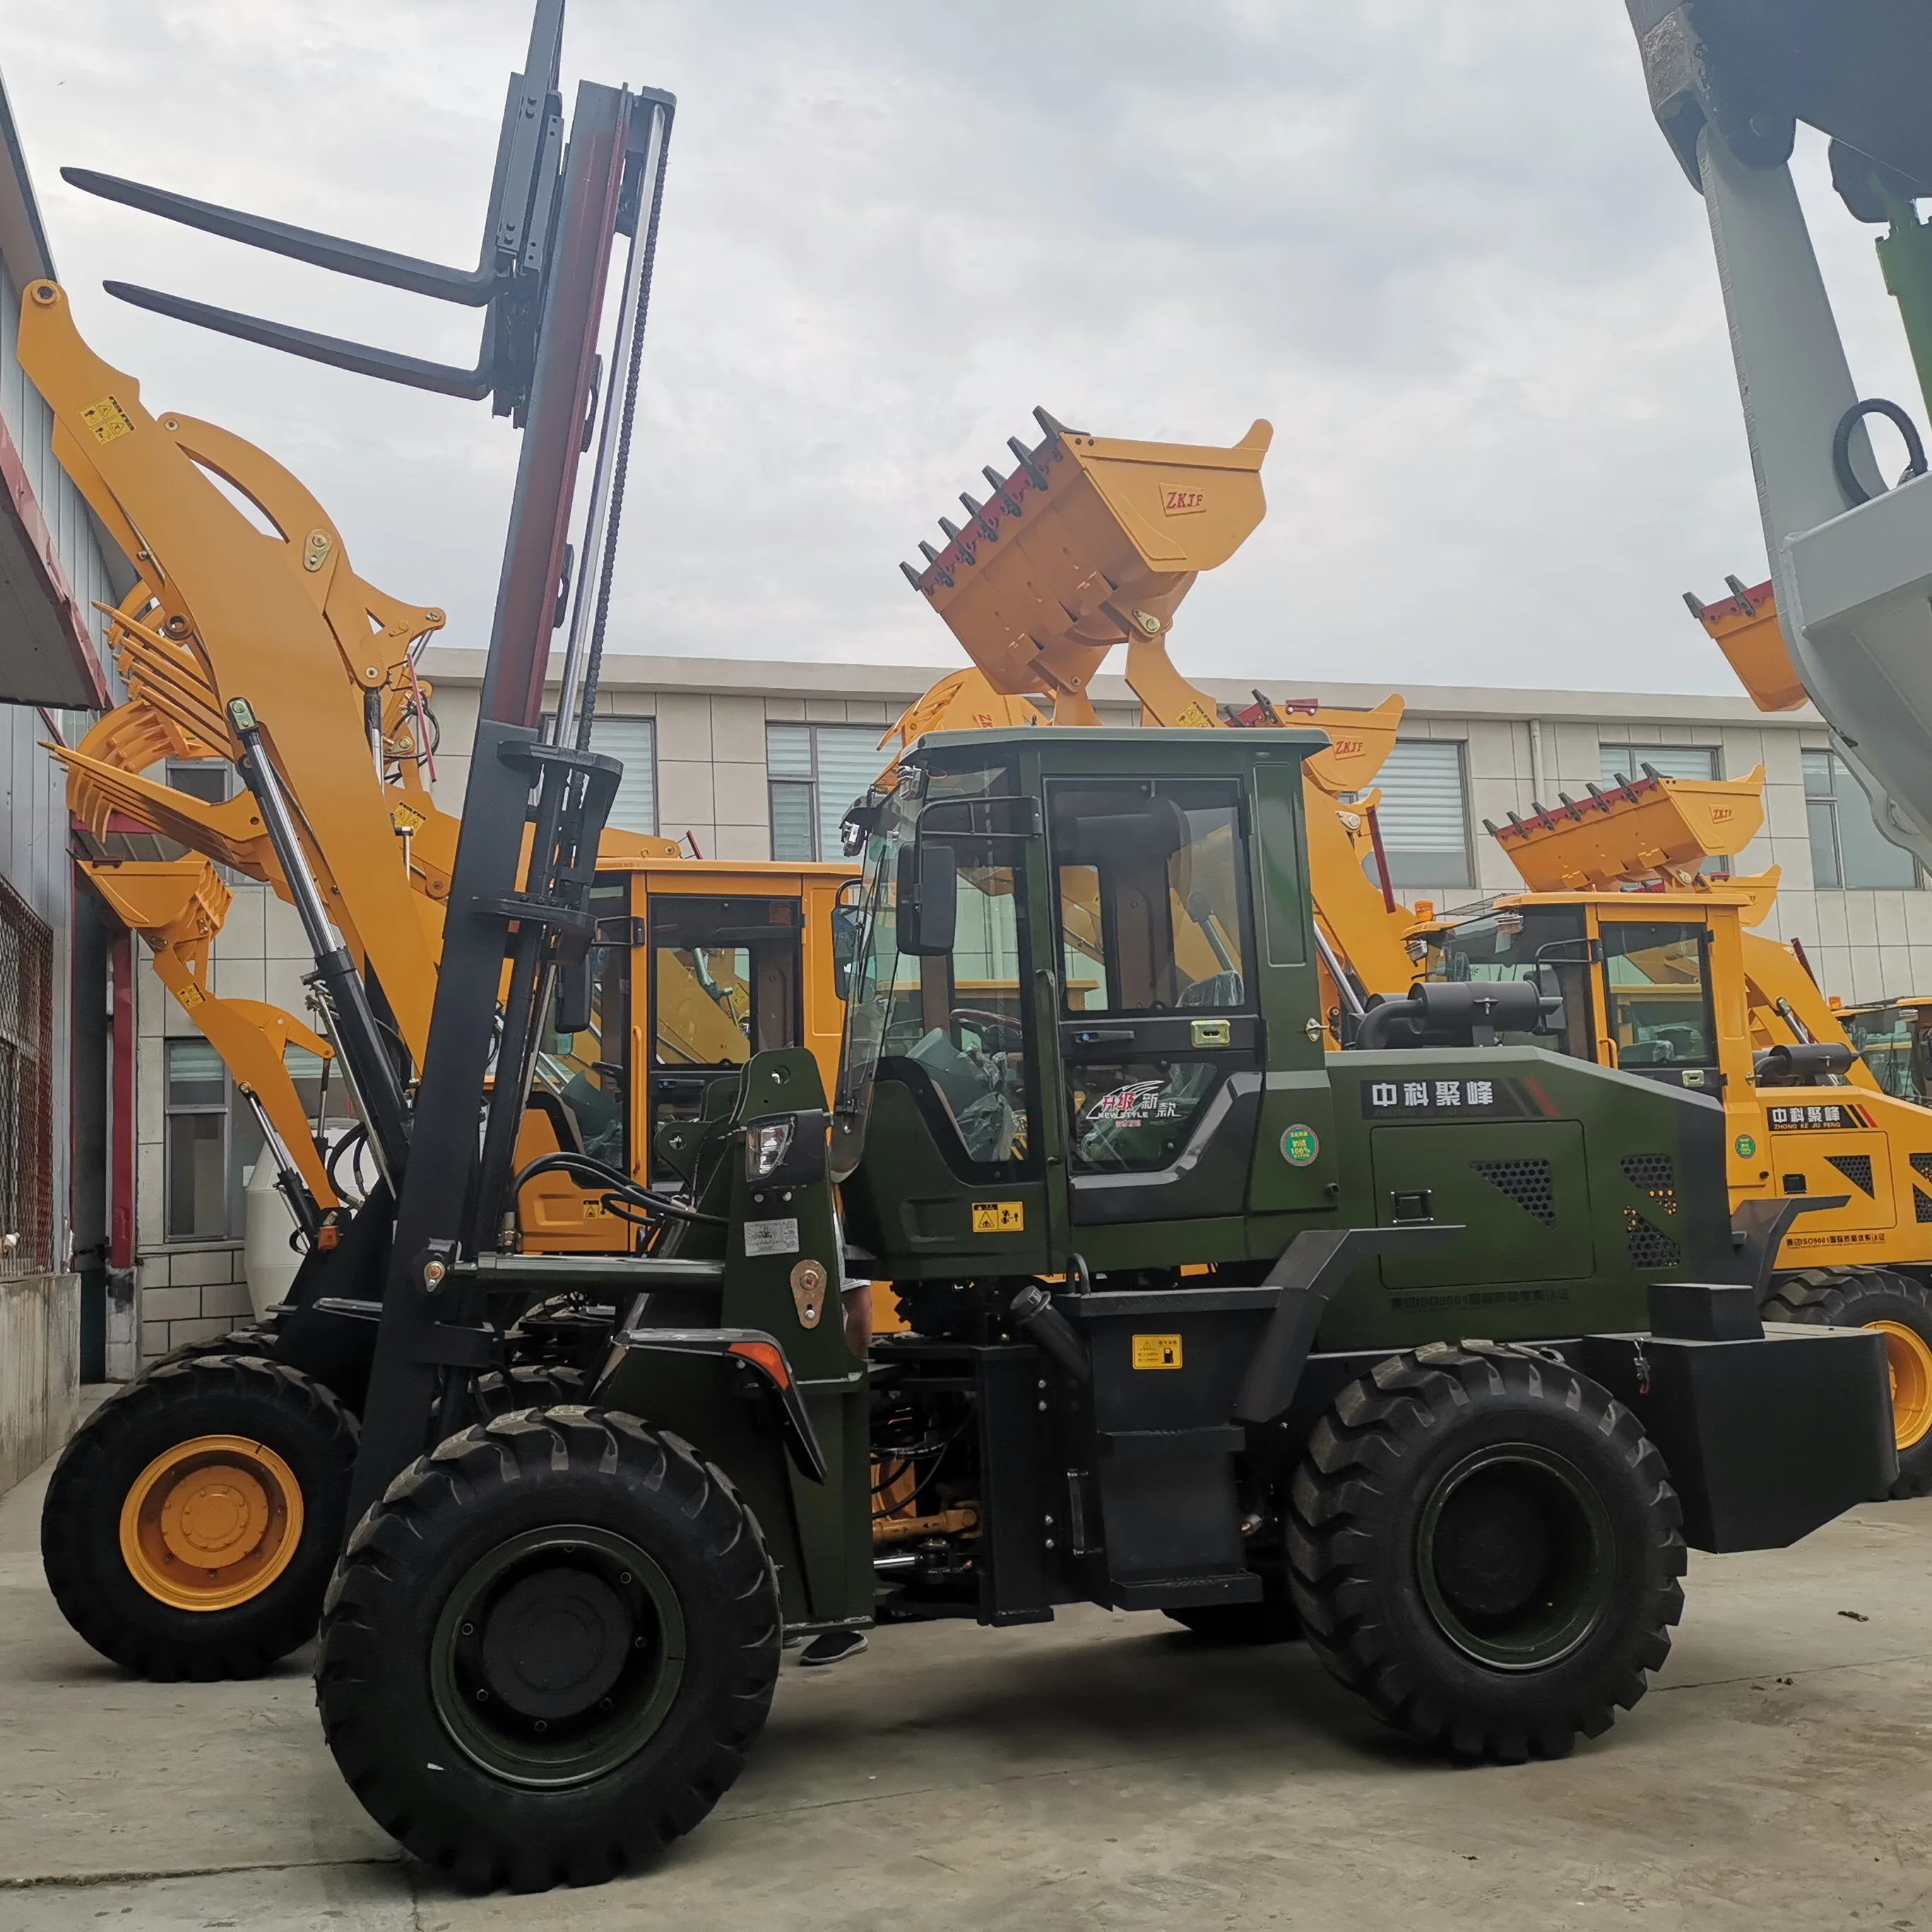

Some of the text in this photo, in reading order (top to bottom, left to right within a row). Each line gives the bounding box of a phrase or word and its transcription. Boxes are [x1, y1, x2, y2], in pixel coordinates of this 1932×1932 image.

[1166, 492, 1203, 509] ZKJF
[1335, 741, 1363, 754] ZKJF
[1373, 1081, 1493, 1107] 中科聚峰
[1772, 1106, 1840, 1123] 中科聚峰
[1291, 1146, 1311, 1155] 100%
